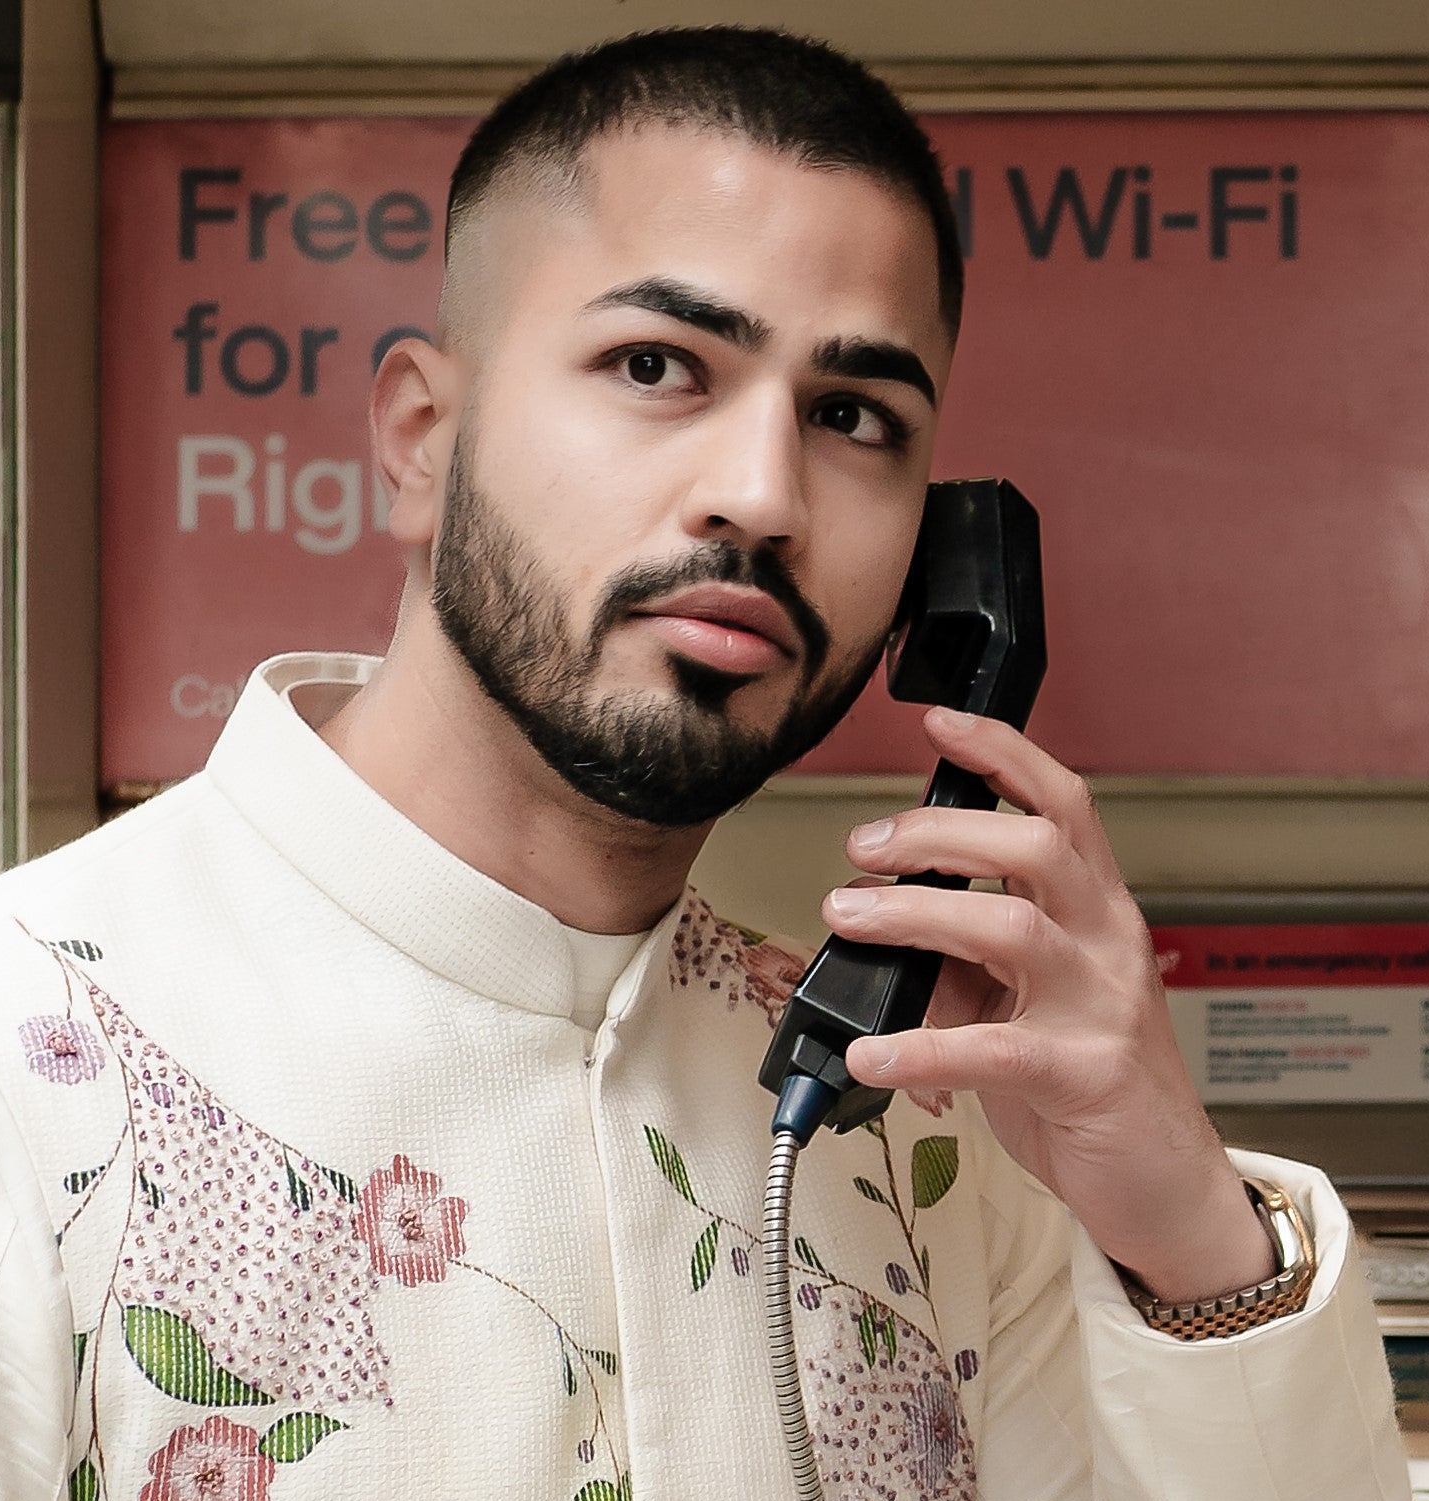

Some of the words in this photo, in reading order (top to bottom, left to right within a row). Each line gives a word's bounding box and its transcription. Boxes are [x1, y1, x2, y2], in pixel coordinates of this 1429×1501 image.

[177, 167, 434, 264] Free
[1006, 164, 1299, 261] Wi-Fi
[172, 301, 340, 397] for
[177, 433, 392, 555] Rig
